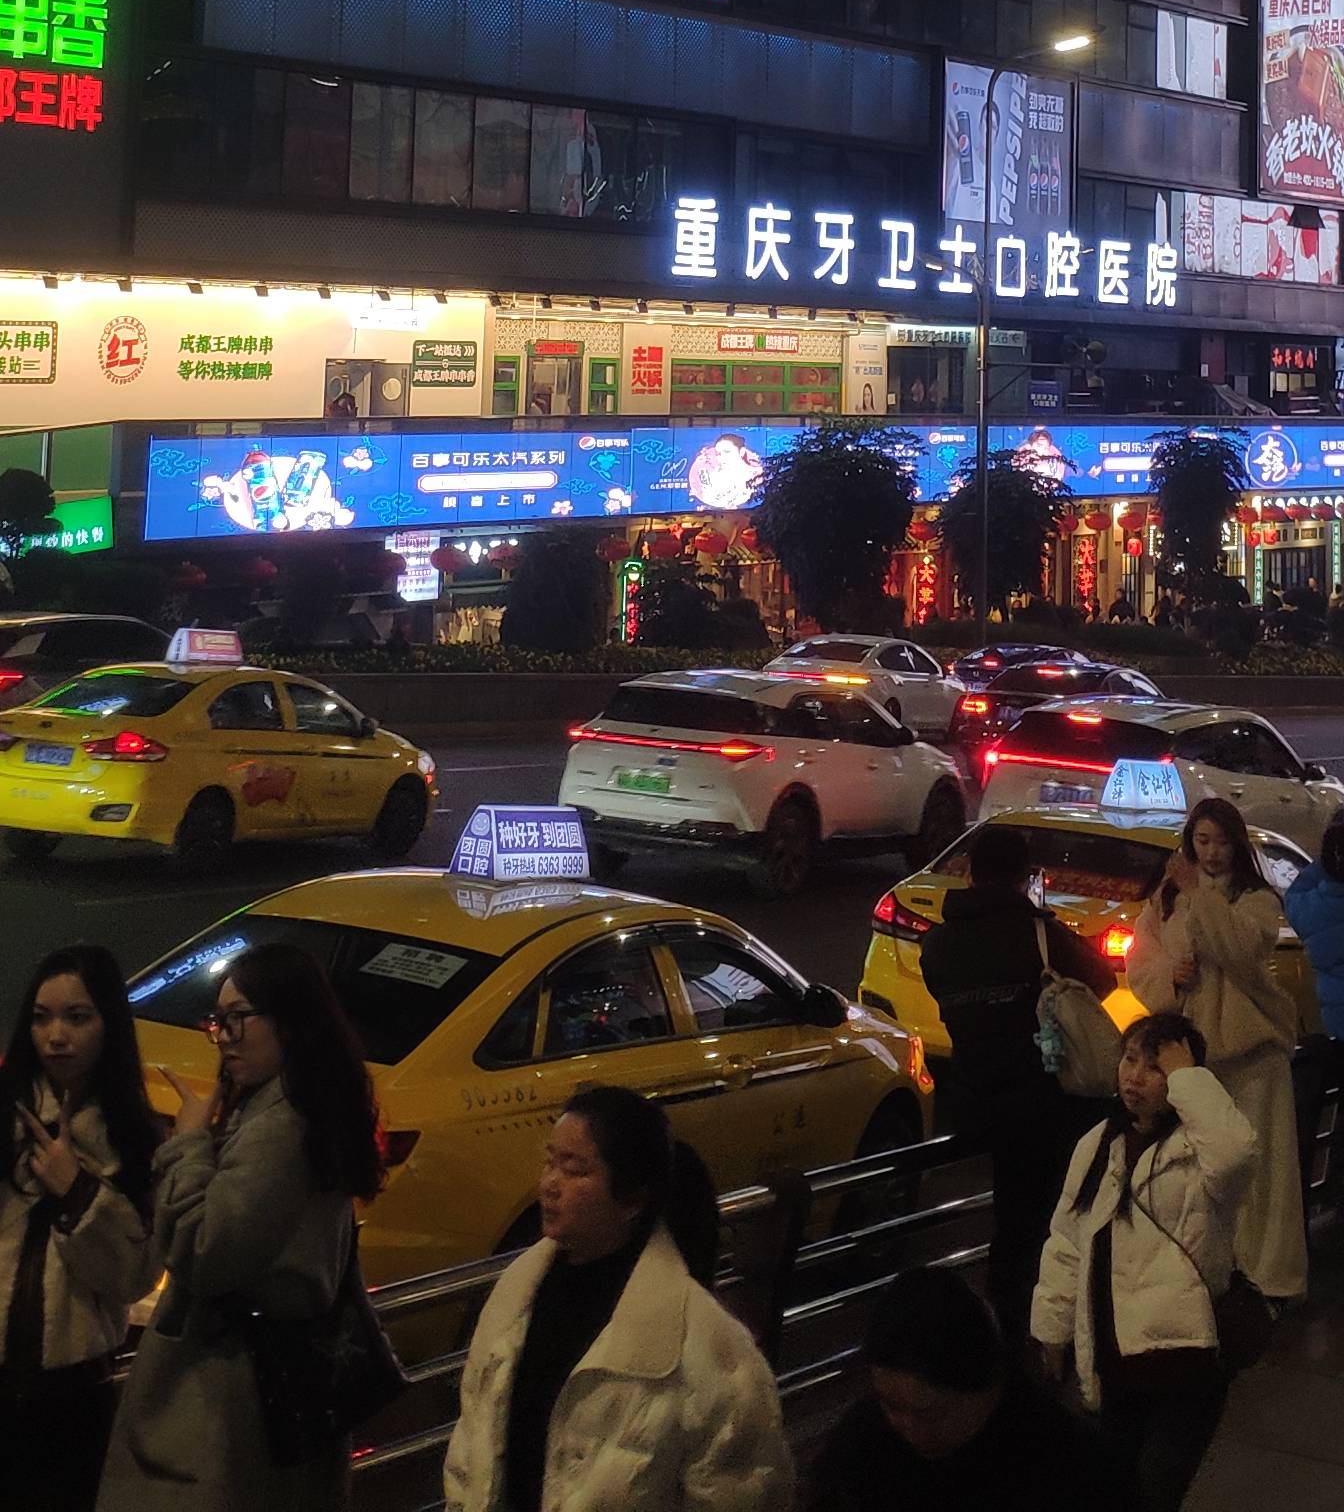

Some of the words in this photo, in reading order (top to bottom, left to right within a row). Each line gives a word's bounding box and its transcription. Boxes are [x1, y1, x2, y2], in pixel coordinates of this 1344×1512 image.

[670, 197, 1179, 308] 重庆牙卫士口腔医院
[105, 334, 140, 369] 红
[178, 334, 274, 355] 成都王牌串串
[412, 451, 565, 468] 百事可乐太汽系列
[498, 821, 539, 848] 种好牙
[541, 821, 582, 848] 到团圆
[460, 837, 492, 858] 团圆
[458, 857, 489, 875] 口腔
[503, 858, 536, 875] 种牙热线
[537, 856, 560, 874] 6363
[562, 856, 583, 873] 9999
